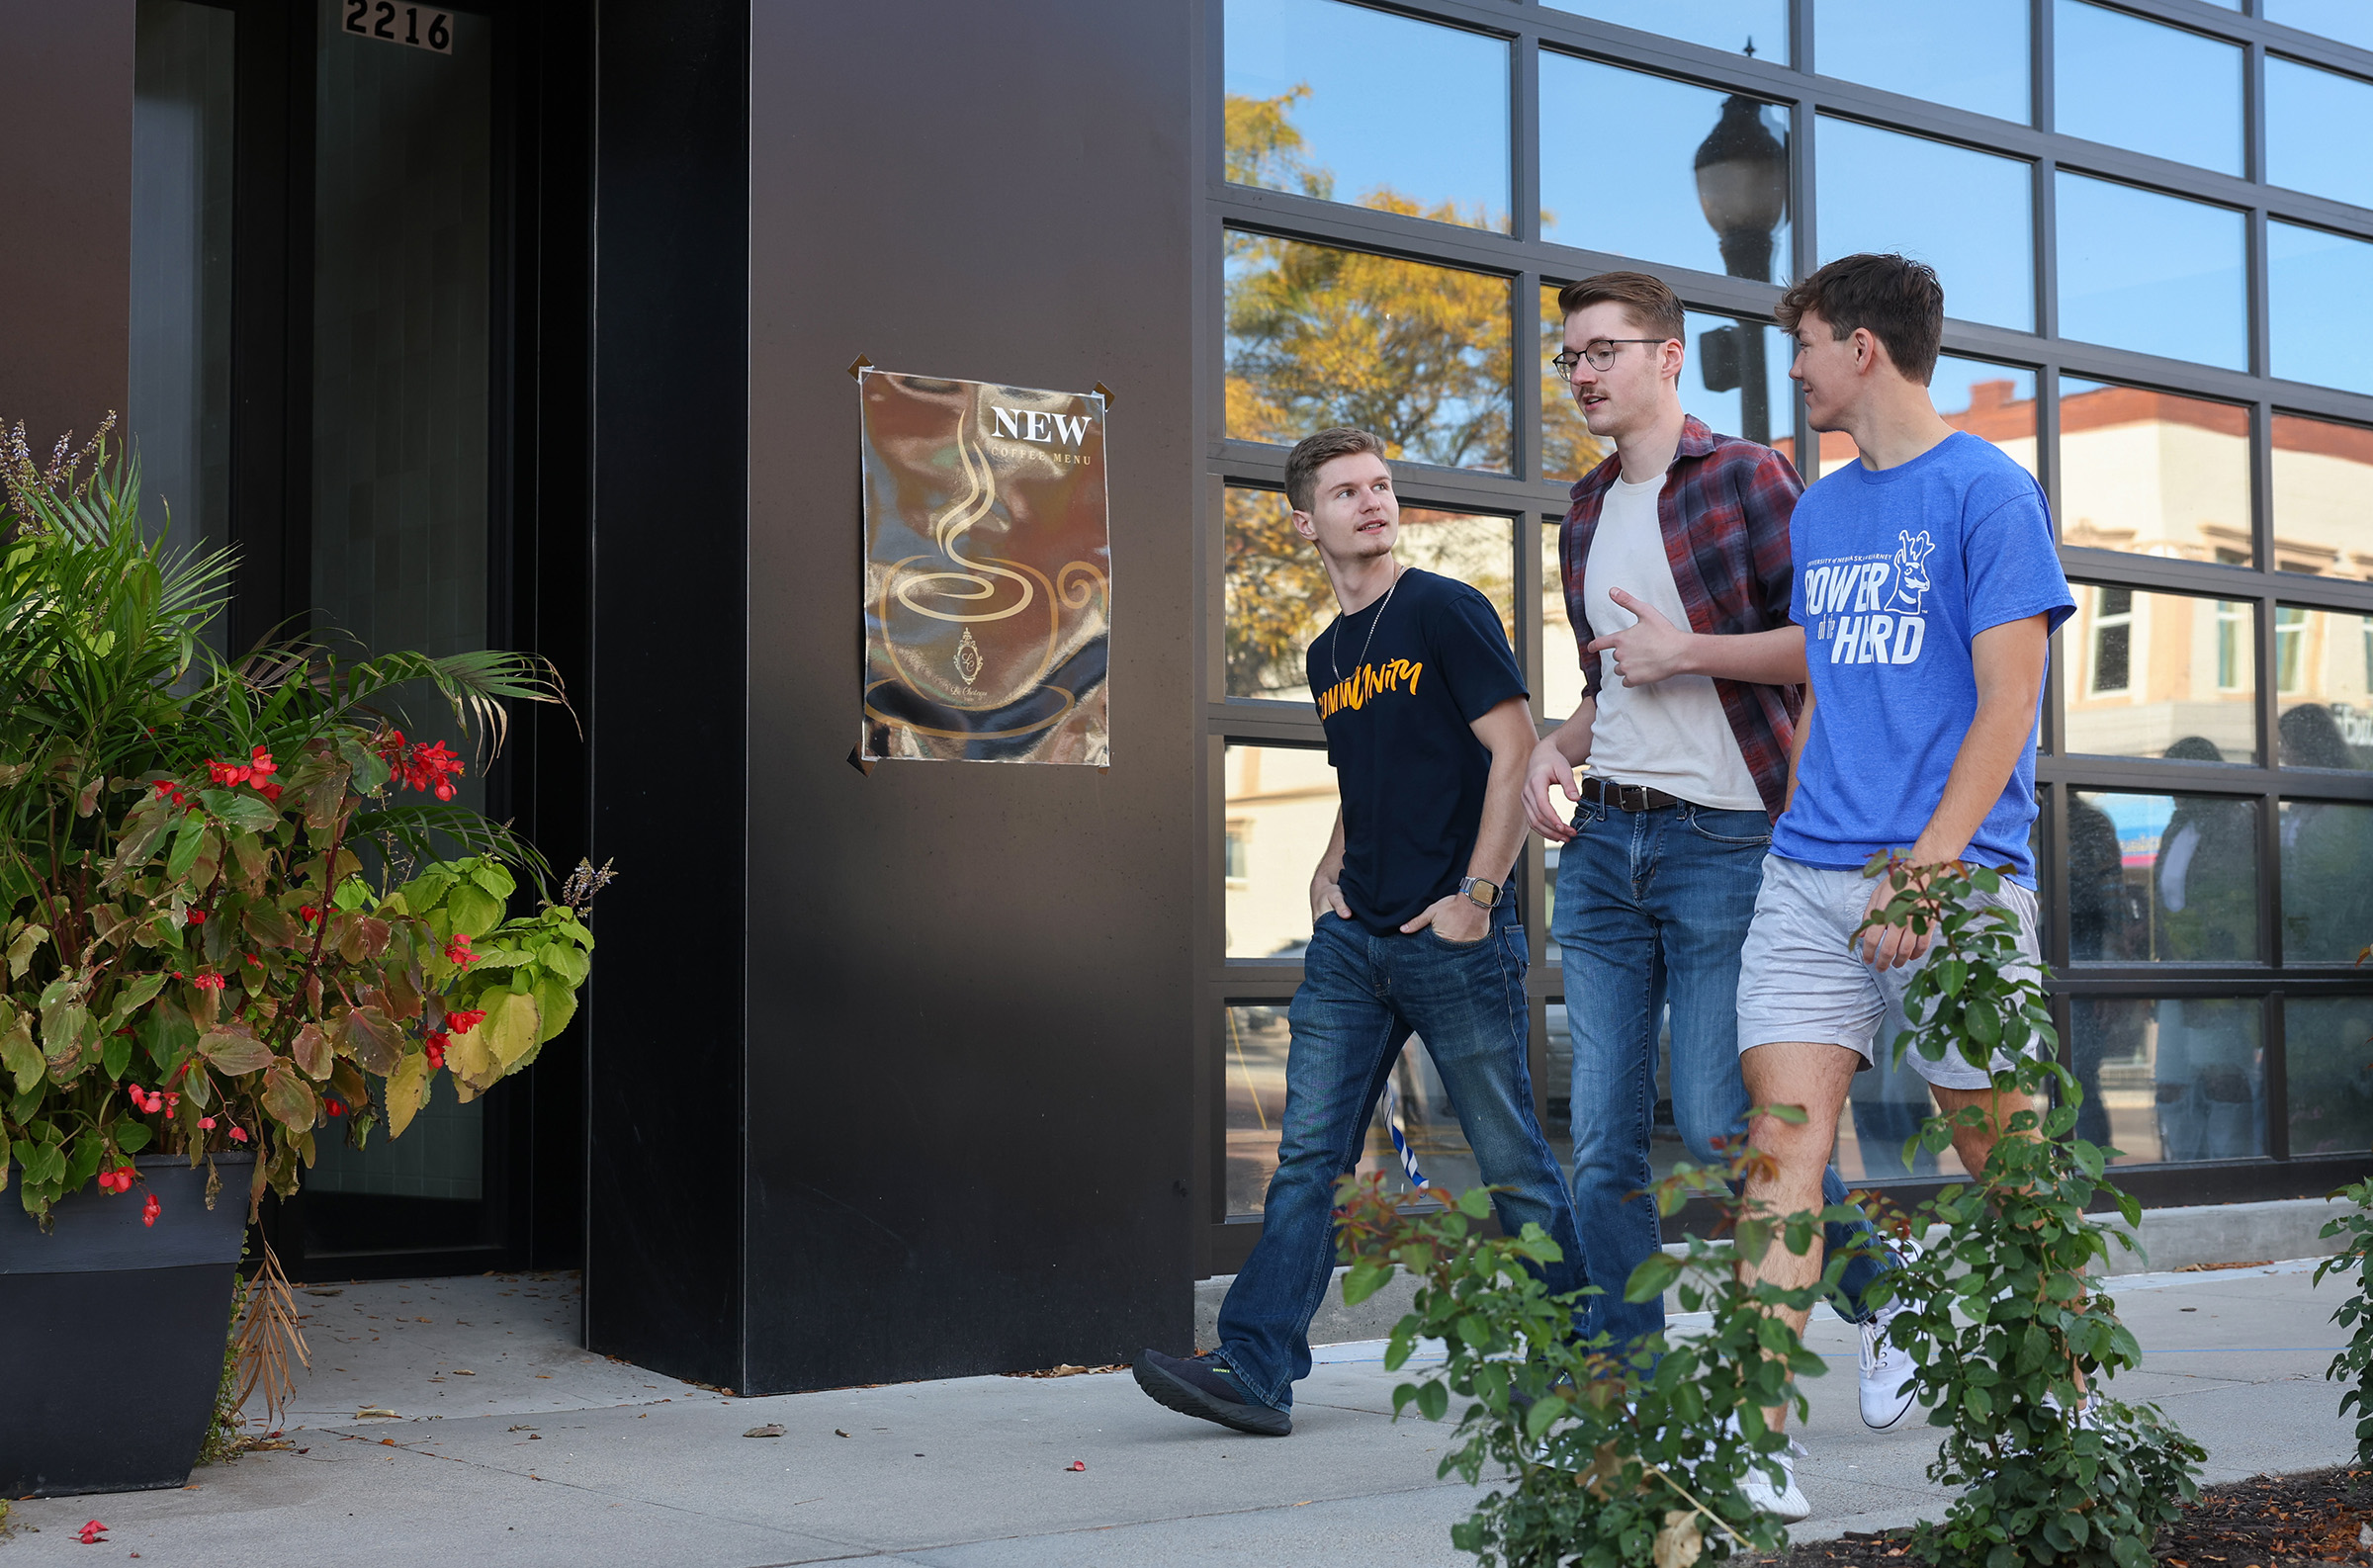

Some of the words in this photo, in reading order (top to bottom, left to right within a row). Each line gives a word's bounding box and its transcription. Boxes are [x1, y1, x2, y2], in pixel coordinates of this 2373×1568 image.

[346, 0, 450, 50] 2216
[991, 405, 1093, 447] NEW
[991, 447, 1046, 461] COFFEE
[1053, 453, 1091, 466] MENU
[1806, 558, 1832, 567] IVERSITY
[1837, 555, 1865, 564] NEBASK
[1804, 563, 1890, 617] POWER
